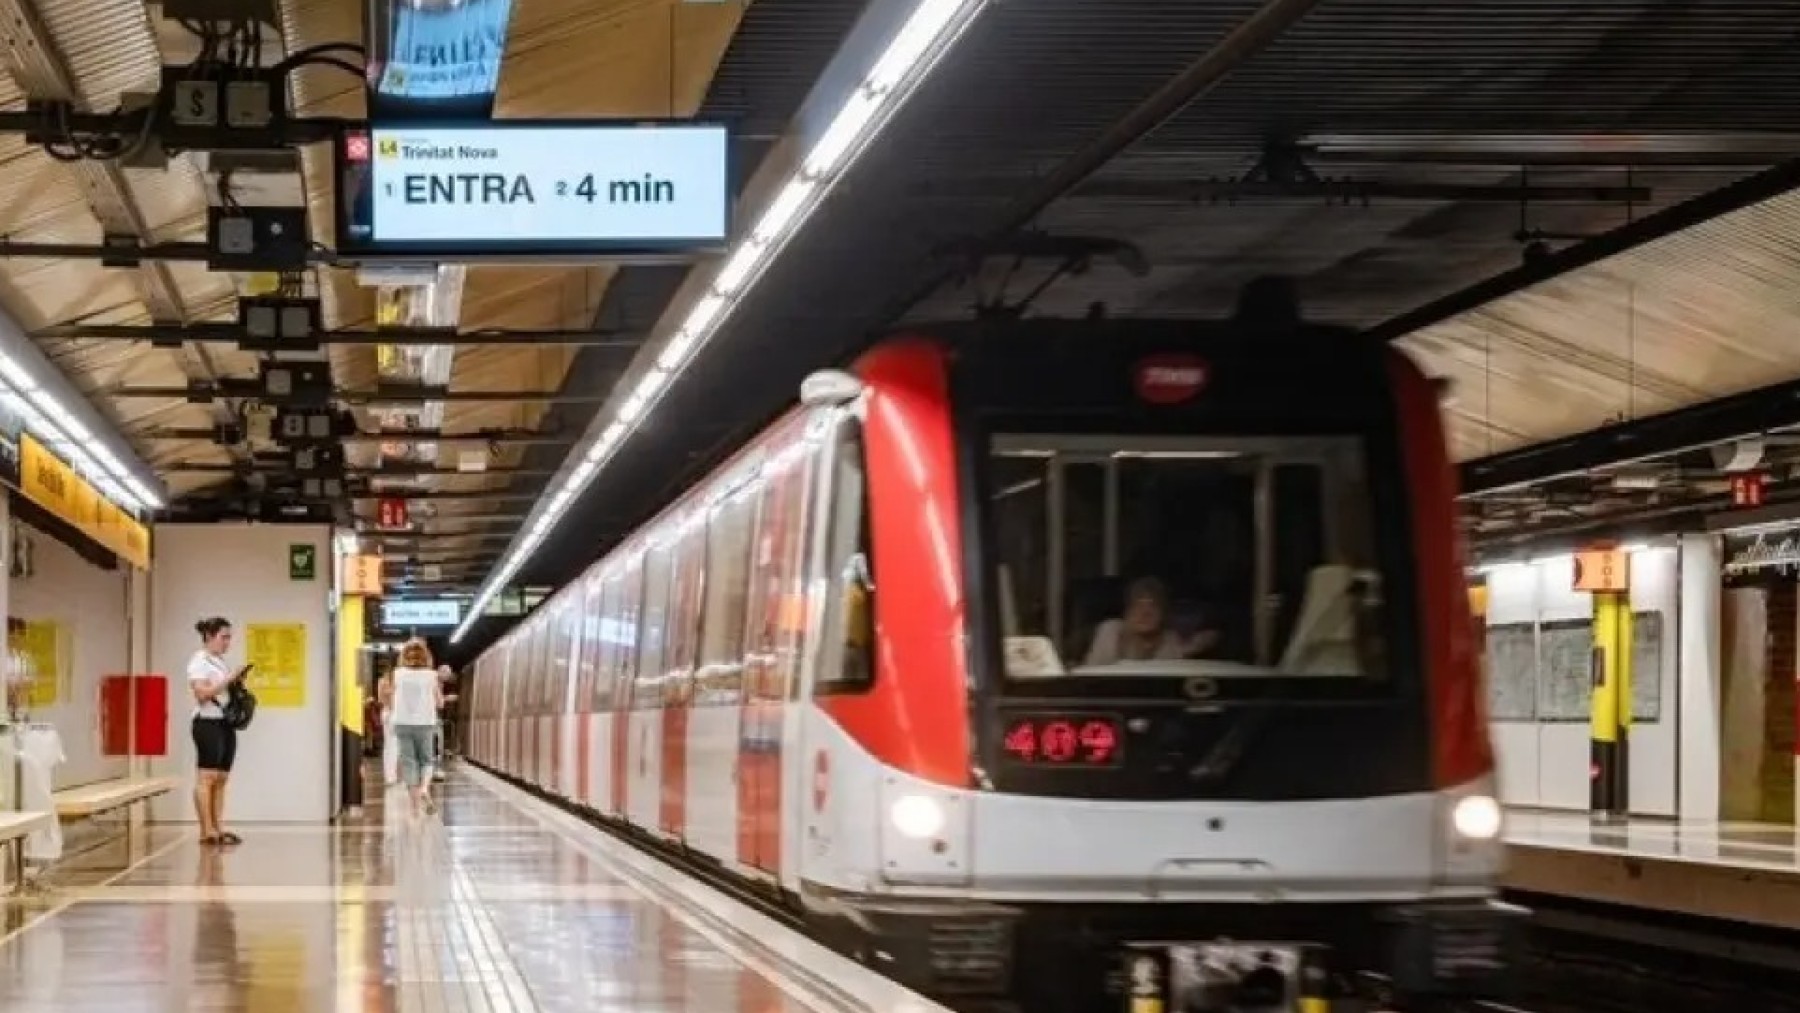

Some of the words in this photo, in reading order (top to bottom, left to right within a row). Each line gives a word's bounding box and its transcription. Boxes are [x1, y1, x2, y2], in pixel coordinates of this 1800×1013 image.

[378, 140, 398, 156] L4
[402, 144, 456, 160] Trinitat
[459, 144, 499, 160] Nova
[404, 173, 535, 204] ENTRA
[575, 173, 598, 204] 4
[608, 172, 675, 204] min
